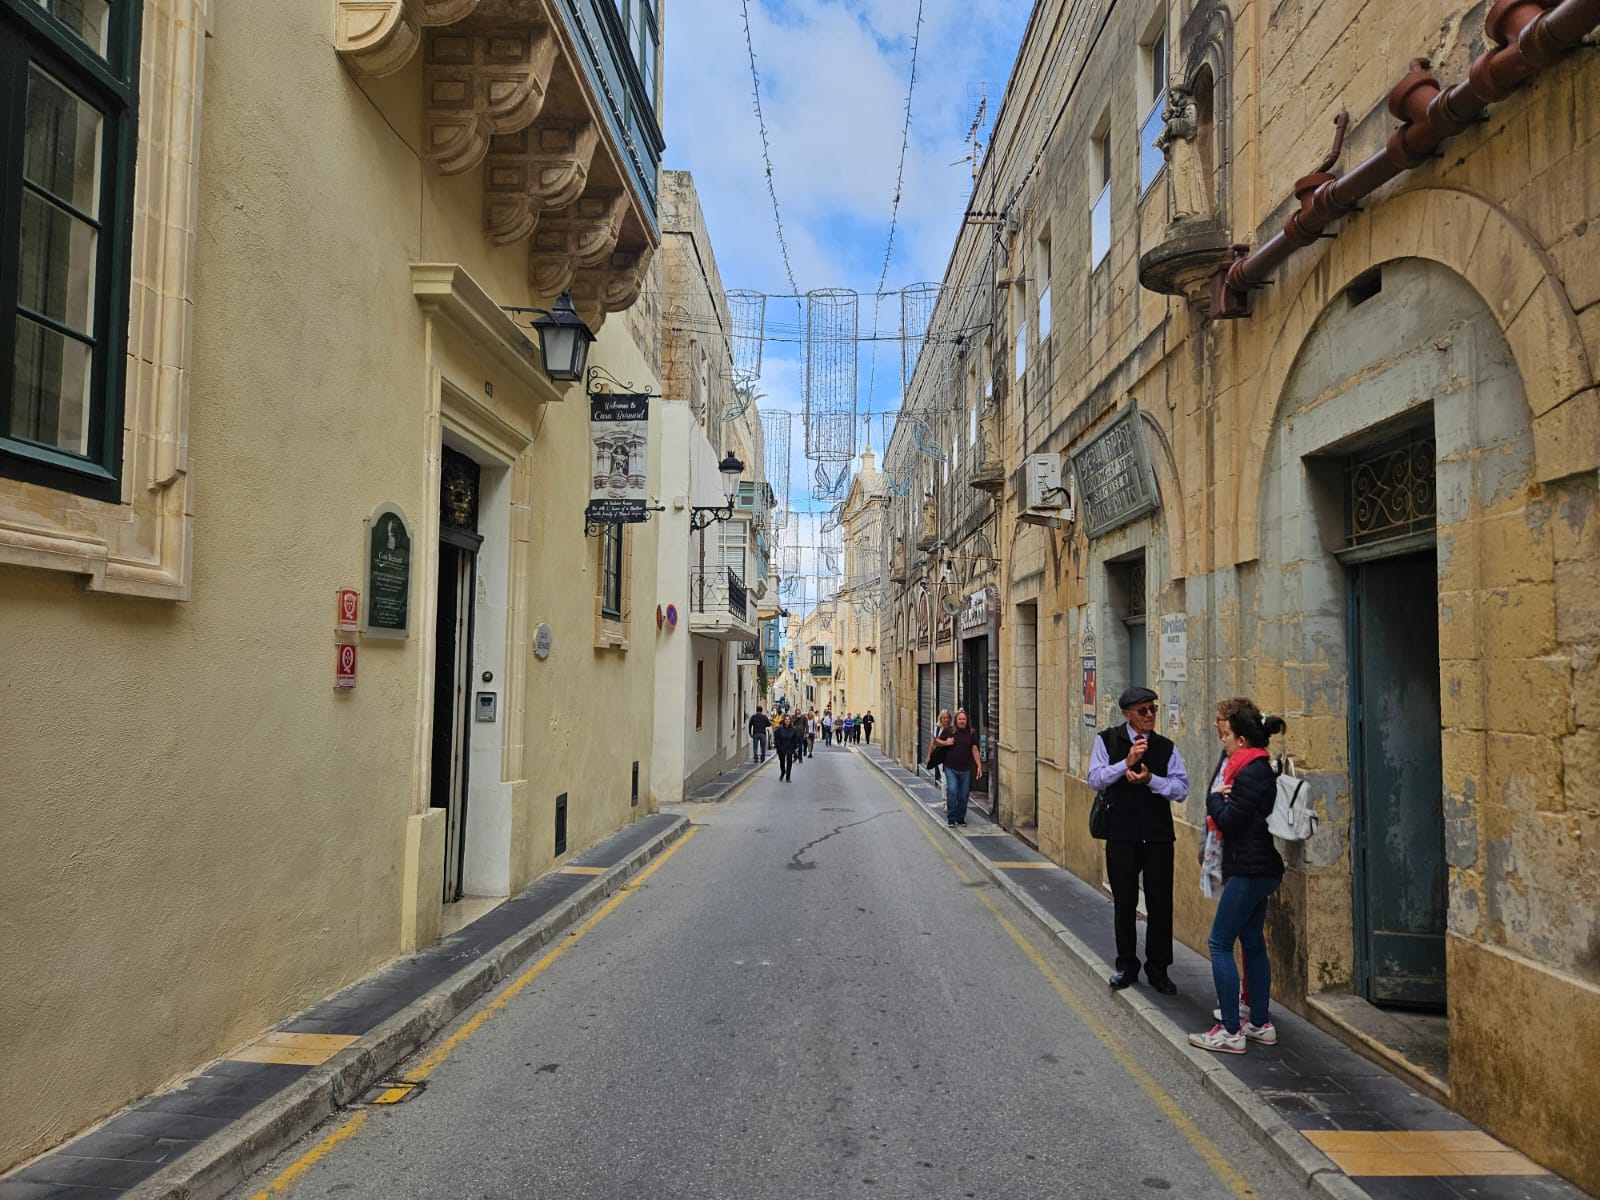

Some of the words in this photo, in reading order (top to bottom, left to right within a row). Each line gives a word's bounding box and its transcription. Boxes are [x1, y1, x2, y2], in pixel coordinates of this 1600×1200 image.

[604, 401, 628, 410] Welcome
[630, 401, 637, 409] to
[594, 410, 612, 420] Casa
[616, 409, 645, 420] Bernard
